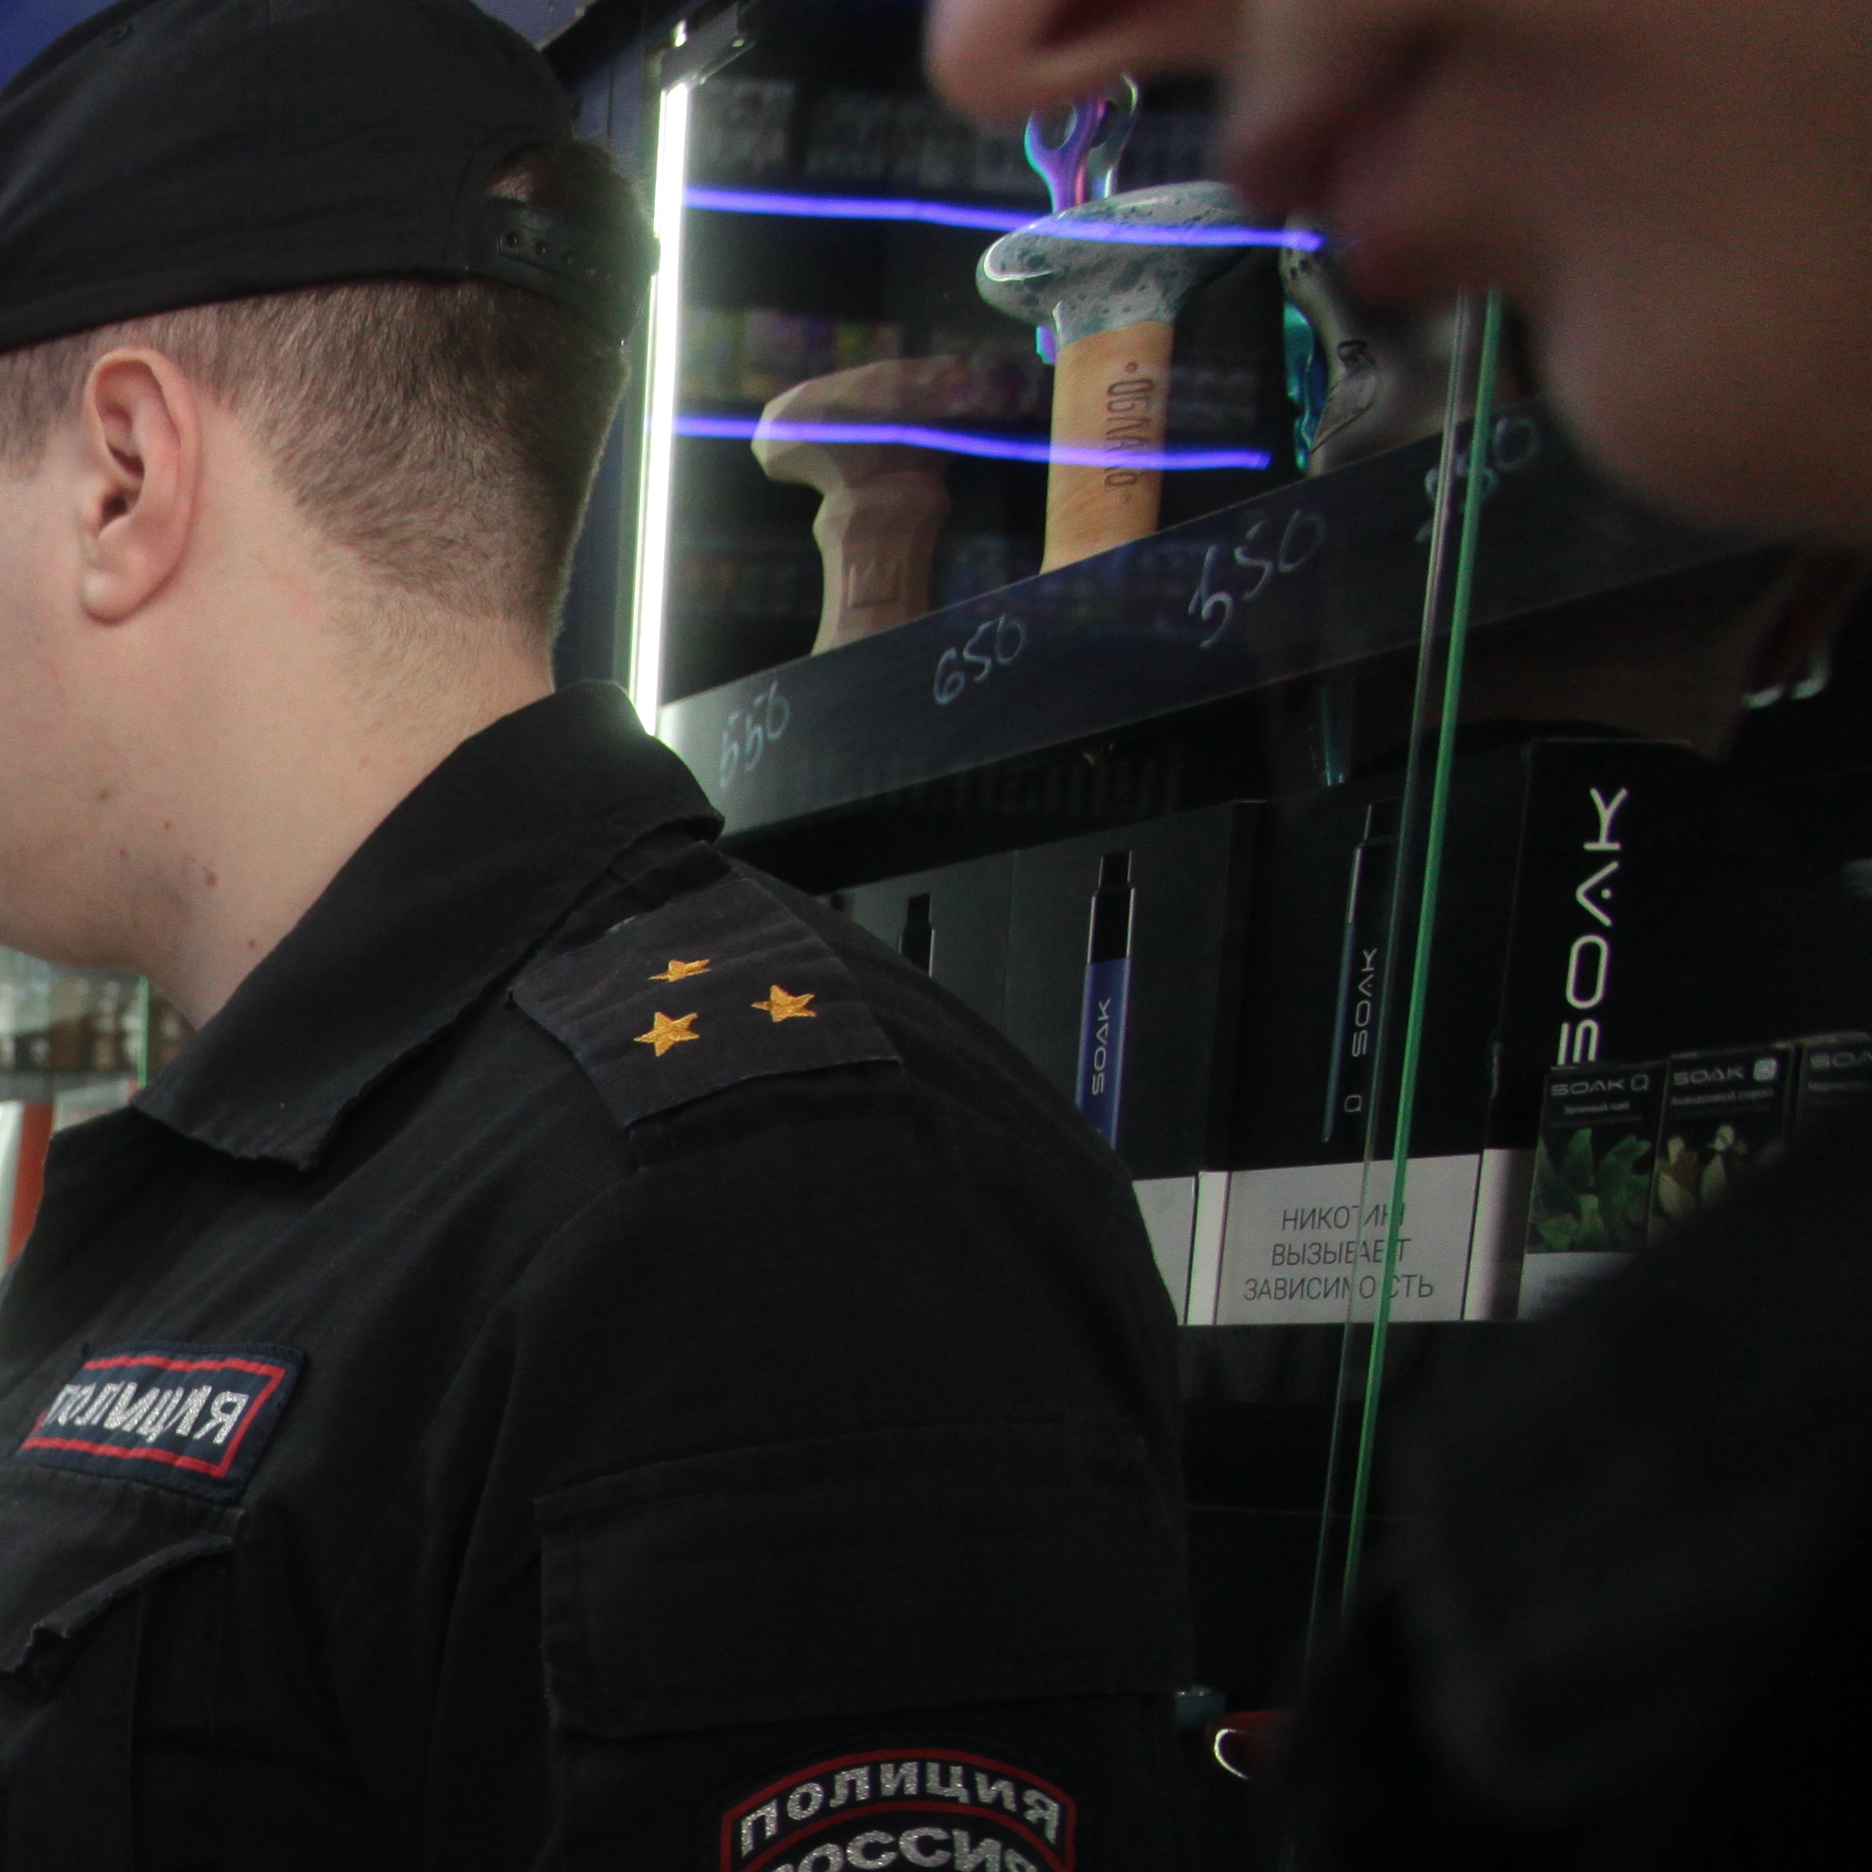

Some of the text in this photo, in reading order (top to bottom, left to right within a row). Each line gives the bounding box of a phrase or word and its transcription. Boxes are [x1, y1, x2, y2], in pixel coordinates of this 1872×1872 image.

[1105, 377, 1155, 487] ОБЛАО
[933, 612, 1027, 705] 650
[1556, 787, 1628, 1066] SOAK
[1091, 997, 1112, 1096] SOAK
[1351, 947, 1378, 1058] SOAK
[1550, 1073, 1650, 1097] SOAK Q
[1672, 1064, 1744, 1087] SOAK
[43, 1380, 249, 1446] ПОЛИЦИЯ
[740, 1760, 1062, 1859] ПОЛИЦИЯ
